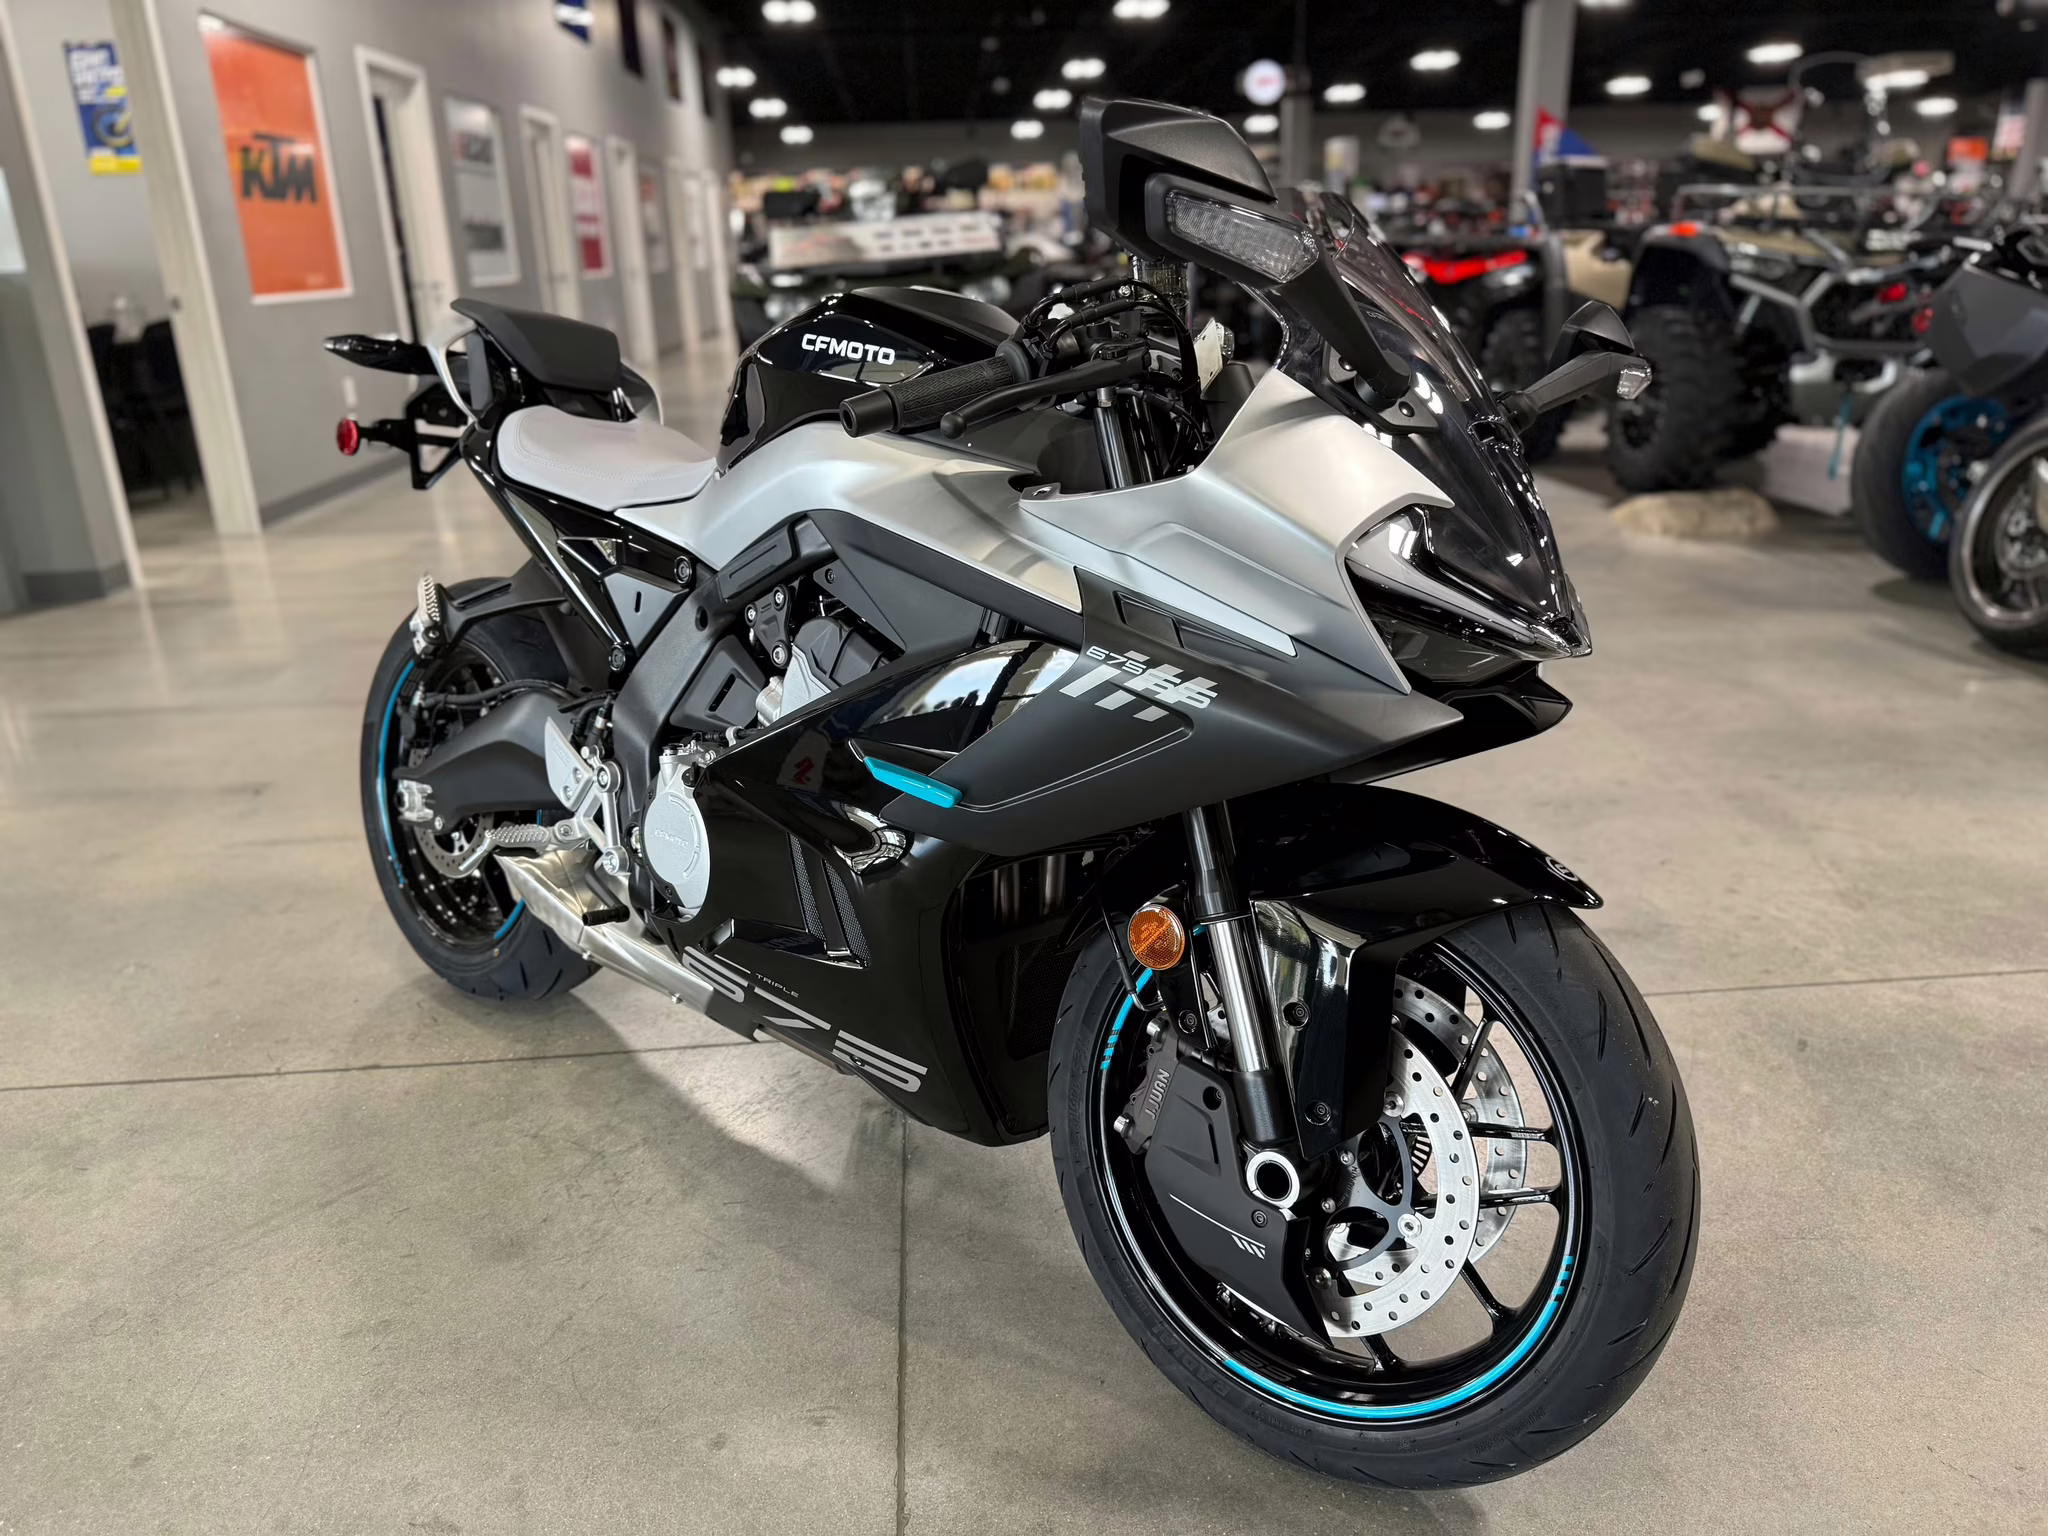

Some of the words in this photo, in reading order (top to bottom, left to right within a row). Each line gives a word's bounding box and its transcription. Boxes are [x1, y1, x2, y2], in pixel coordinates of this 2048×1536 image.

[242, 133, 317, 203] KTM
[801, 333, 896, 365] CFMOTO
[1086, 645, 1147, 675] 675
[755, 973, 800, 999] TRIPLE
[682, 945, 928, 1093] 675
[1145, 1068, 1170, 1120] J.JUAN
[1151, 1322, 1233, 1397] RADIAL
